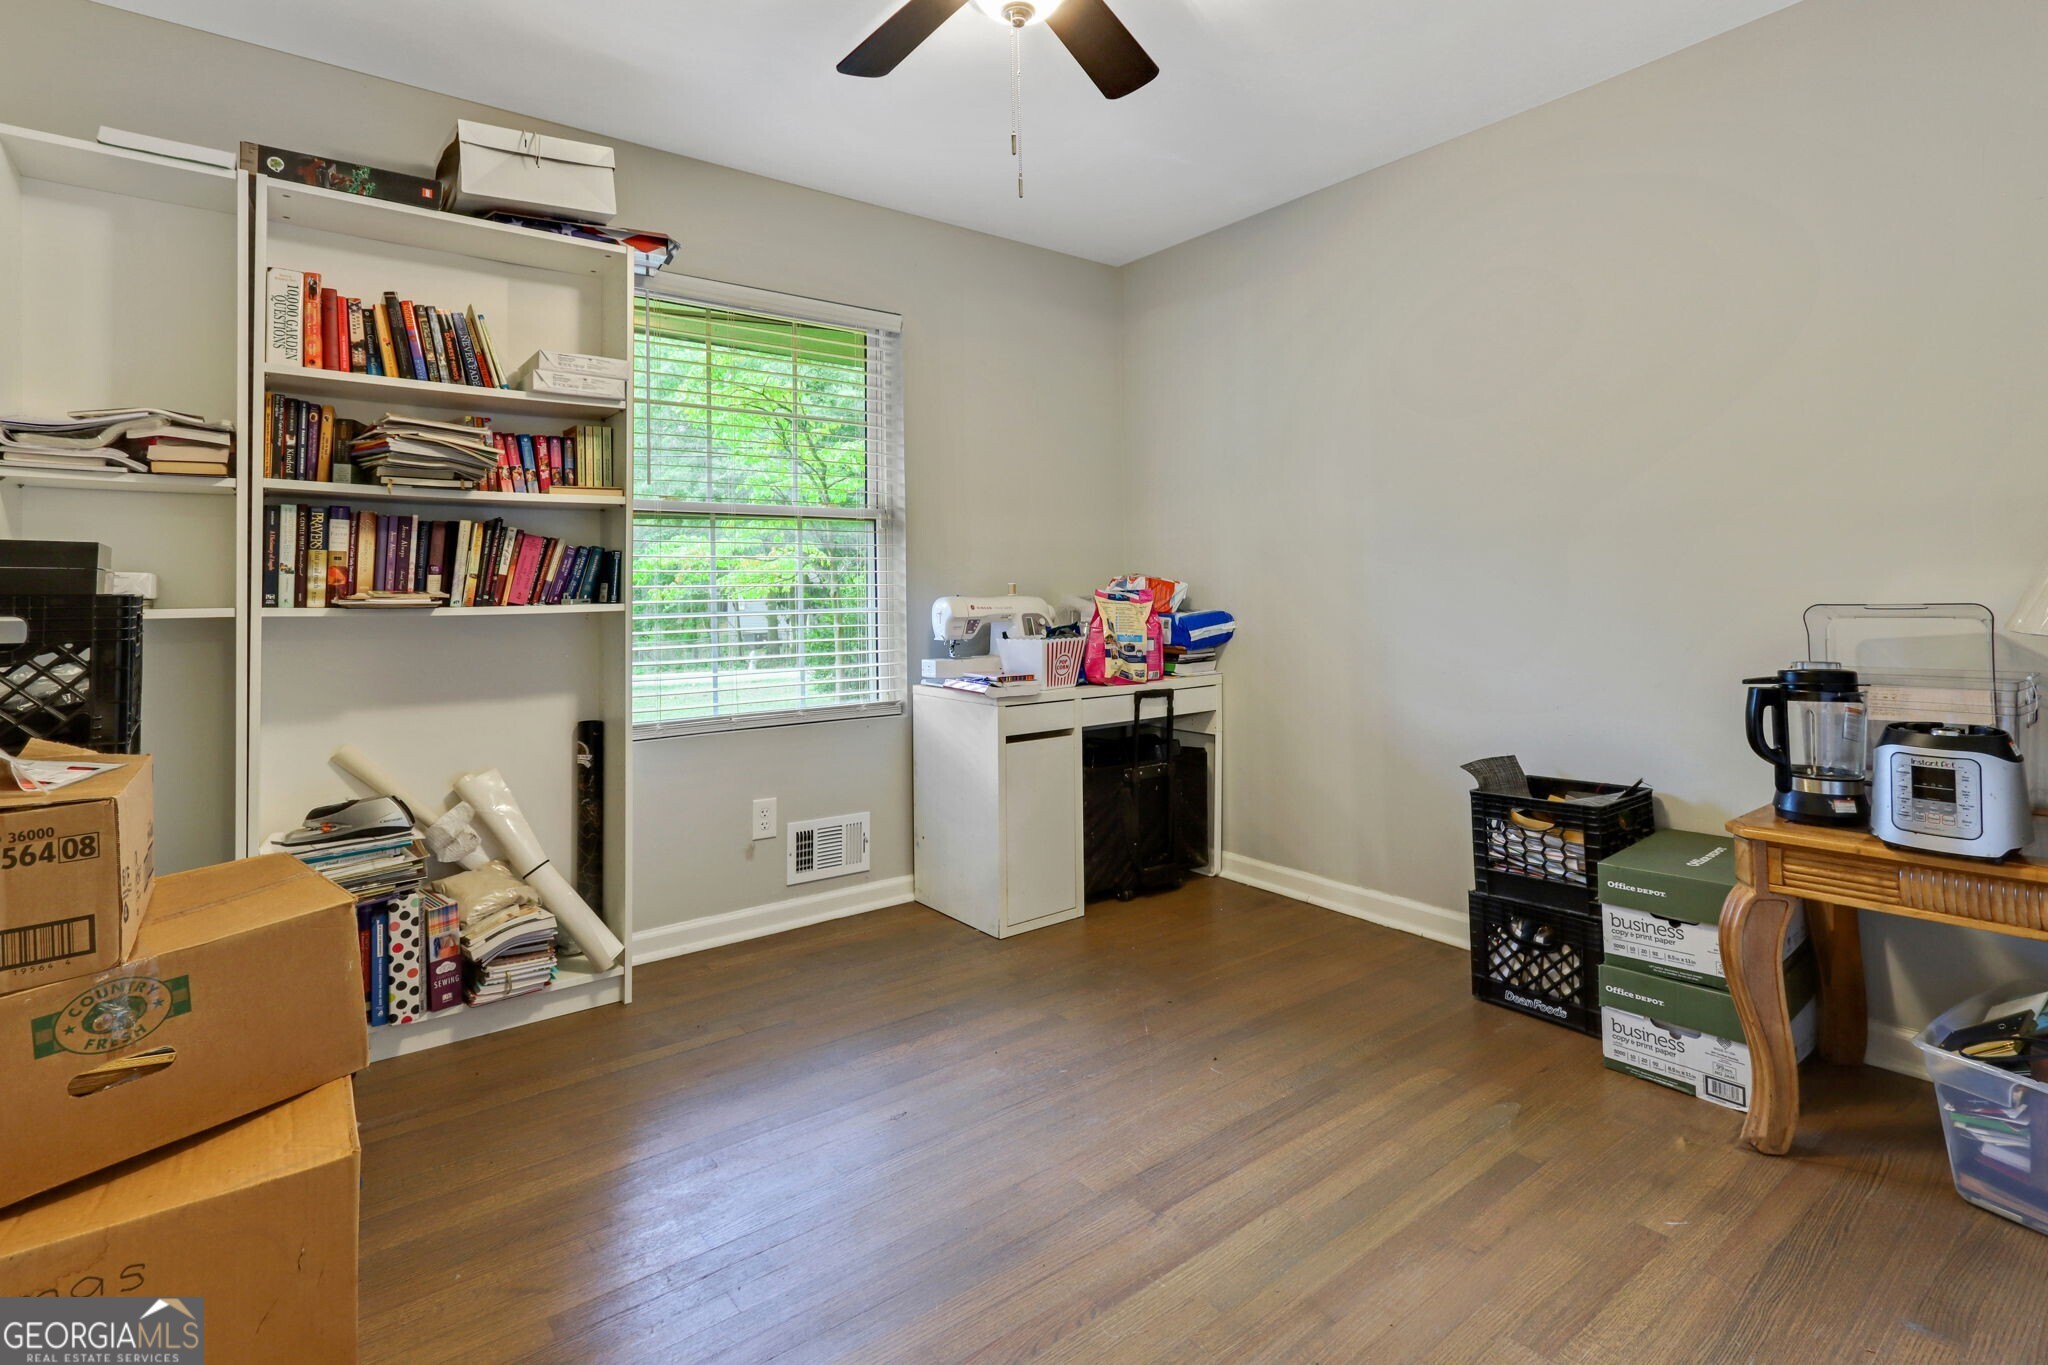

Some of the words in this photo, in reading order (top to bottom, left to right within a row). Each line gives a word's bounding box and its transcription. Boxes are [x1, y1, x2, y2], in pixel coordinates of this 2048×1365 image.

[286, 283, 299, 320] 10,000
[271, 295, 286, 349] QUESTIONS
[285, 320, 299, 361] GARDEN
[444, 332, 455, 360] DARKEST
[460, 334, 473, 364] NEVER
[469, 363, 481, 386] FADE
[286, 448, 294, 473] Kindred
[310, 511, 324, 550] PRAYERS
[400, 540, 408, 558] Always
[1911, 757, 1939, 767] Instant
[1940, 761, 1956, 769] Pot
[8, 827, 55, 844] 36000
[1, 841, 56, 870] 564
[62, 835, 97, 860] 08
[1607, 880, 1636, 892] Office
[1636, 887, 1667, 897] DEPOT
[1609, 912, 1685, 941] business
[1611, 928, 1629, 938] copy
[1635, 931, 1653, 942] print
[1654, 936, 1676, 946] paper
[433, 974, 460, 989] SEWING
[68, 980, 160, 1018] COUNTRY
[1605, 985, 1634, 999] Office
[1634, 994, 1665, 1007] DEPOT
[83, 1023, 148, 1051] FRESH
[1611, 1017, 1685, 1054] business
[1612, 1033, 1631, 1045] copy
[1636, 1039, 1654, 1052] print
[1655, 1046, 1677, 1058] paper
